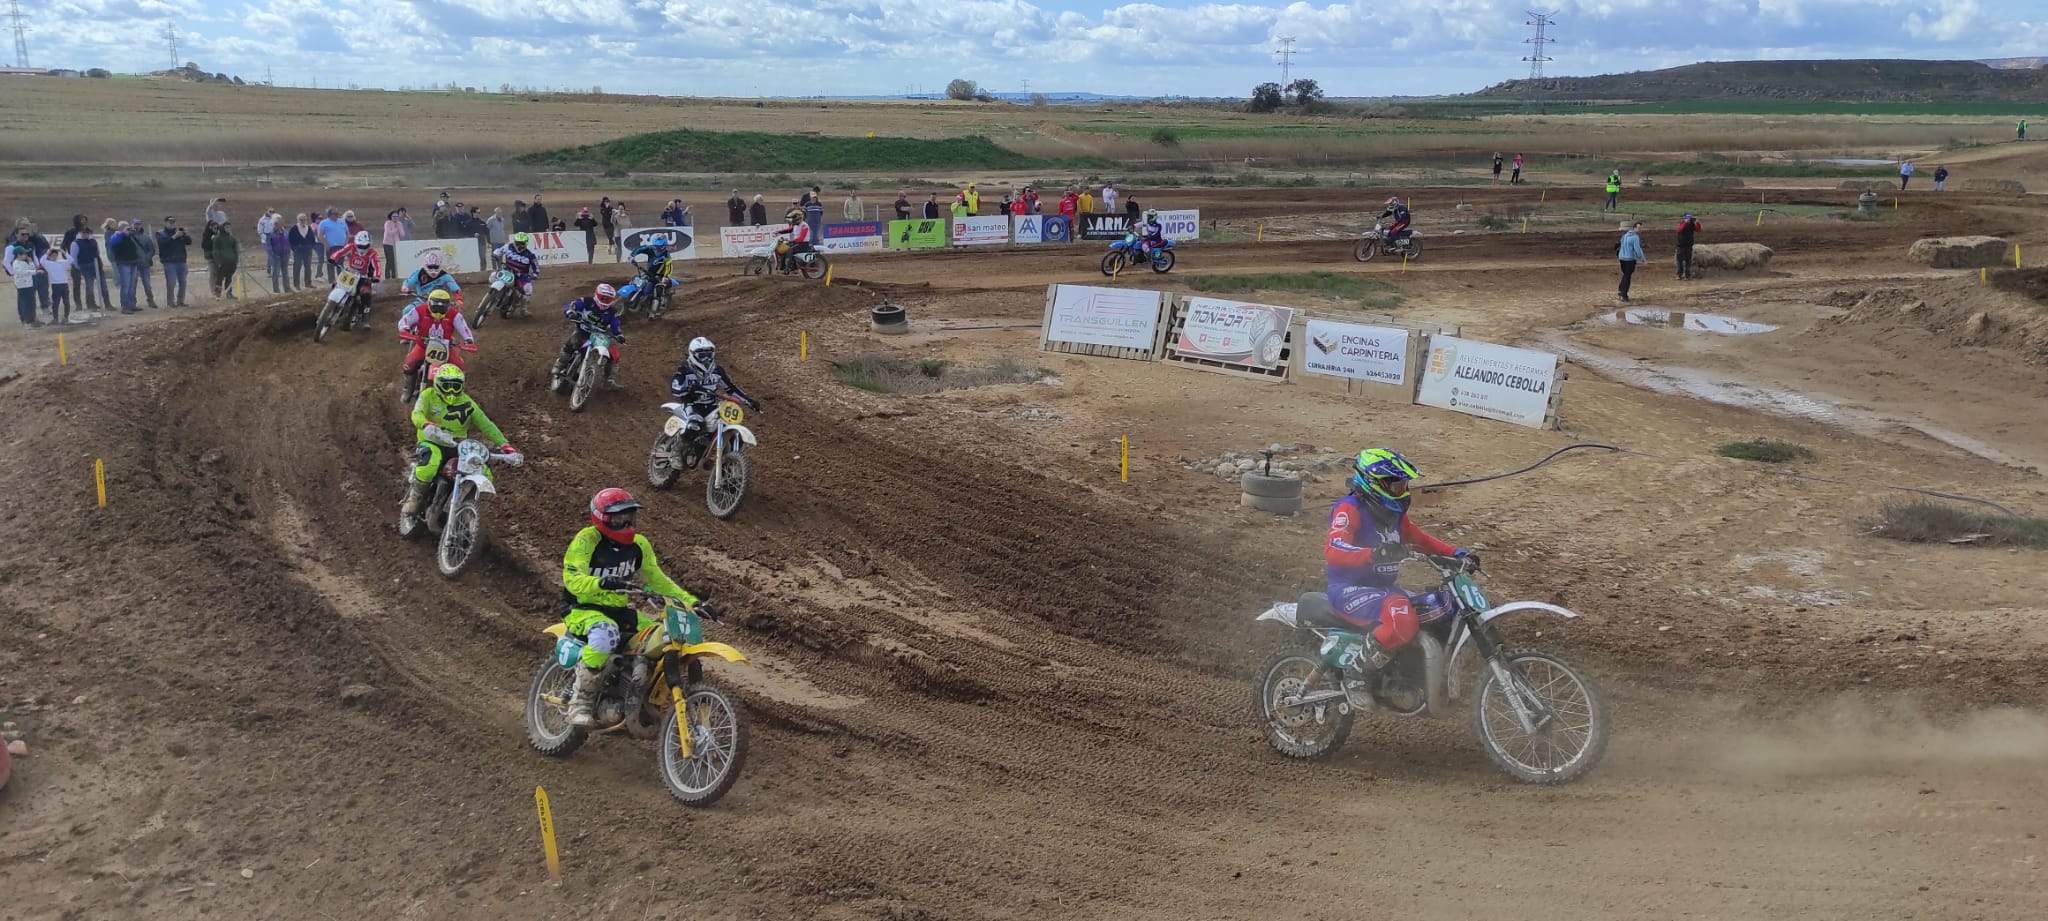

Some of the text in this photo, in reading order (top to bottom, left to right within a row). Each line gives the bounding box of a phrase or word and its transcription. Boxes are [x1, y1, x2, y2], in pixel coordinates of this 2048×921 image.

[967, 223, 1007, 232] san mateo
[1165, 221, 1196, 234] MPO
[532, 232, 564, 250] MX
[838, 240, 879, 249] GLASSDRIVE
[1190, 310, 1253, 328] MONFORT
[1341, 334, 1380, 347] ENCINAS
[428, 349, 446, 361] 40
[1341, 346, 1400, 361] CARPINTERIA
[1455, 366, 1545, 394] ALEJANDRO CEBOLLA
[724, 406, 739, 420] 69
[677, 610, 690, 635] 5
[558, 640, 574, 665] 5
